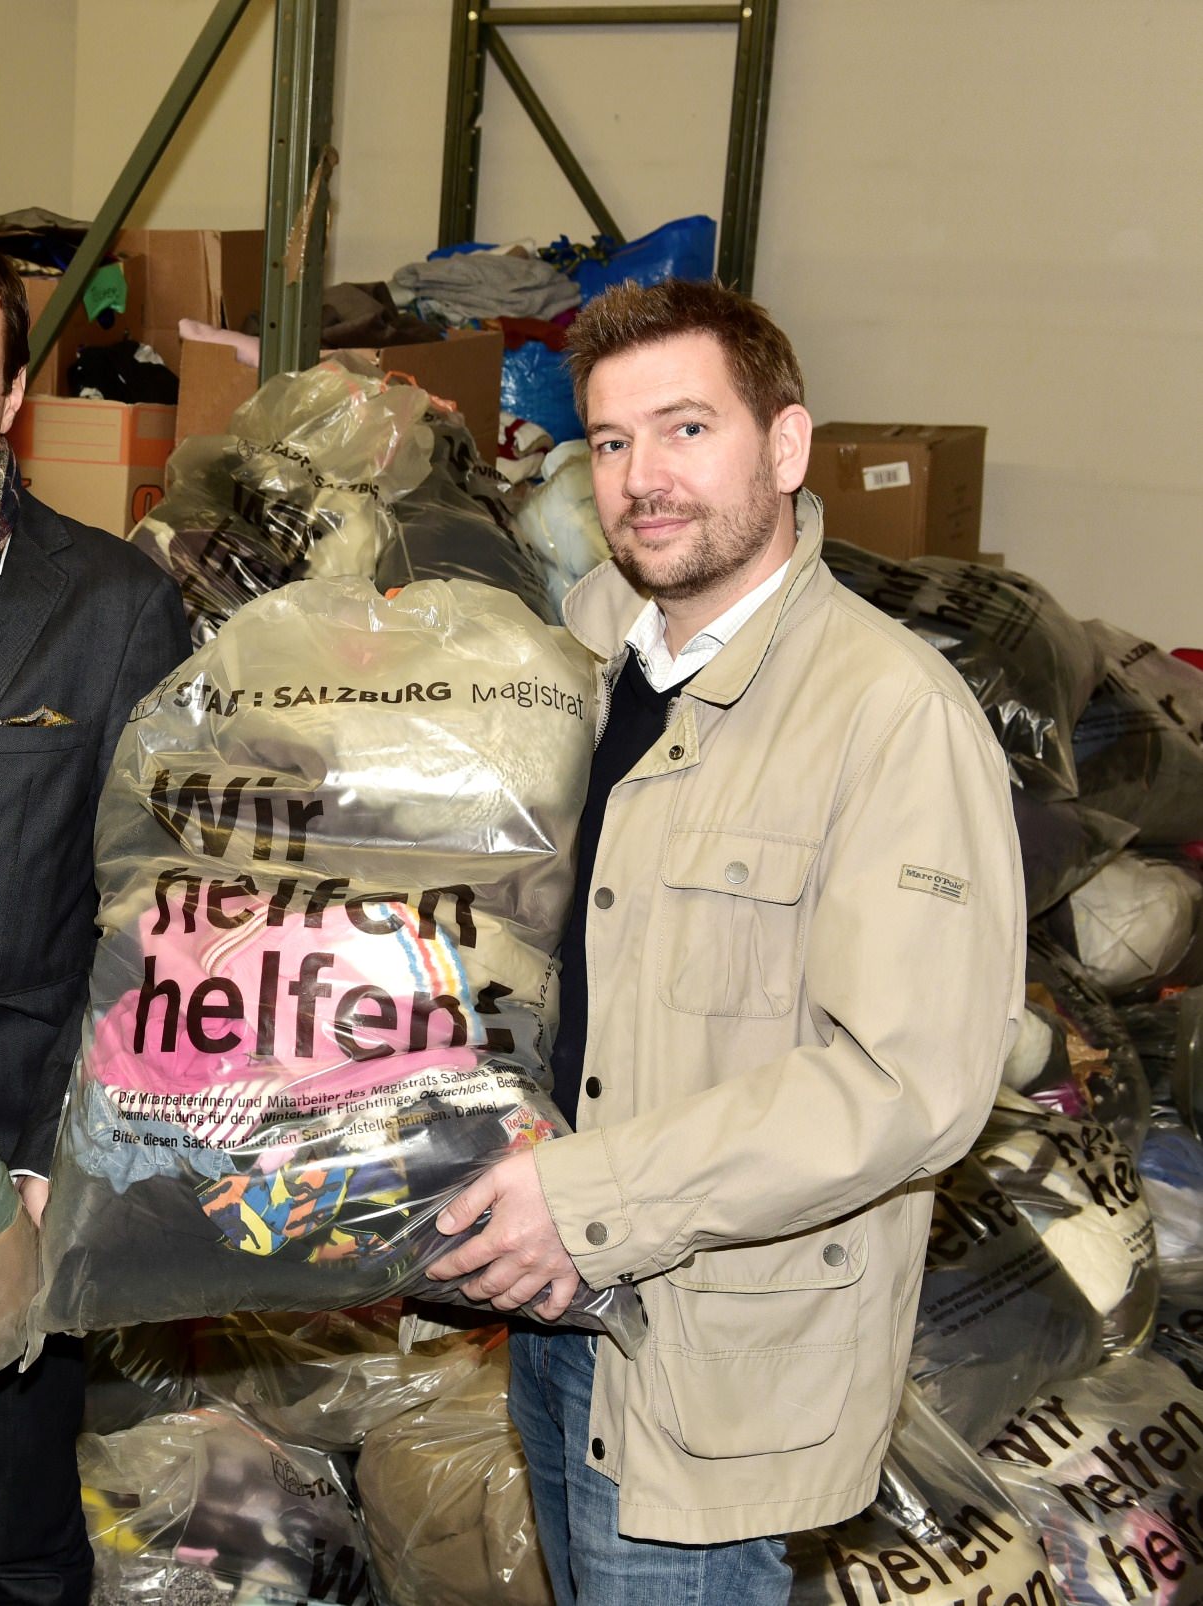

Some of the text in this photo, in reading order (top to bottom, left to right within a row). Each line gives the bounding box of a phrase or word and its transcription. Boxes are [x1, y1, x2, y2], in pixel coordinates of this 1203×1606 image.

[273, 681, 452, 708] SALZBURG
[471, 675, 585, 721] Magistrat
[150, 769, 324, 862] Wir
[905, 868, 933, 881] Marc
[117, 1109, 150, 1122] warme
[153, 1110, 204, 1126] Kleidung
[209, 1110, 227, 1124] für
[230, 1112, 255, 1126] den
[260, 1110, 305, 1125] Winter.
[310, 1103, 333, 1117] Für
[337, 1093, 414, 1115] Flüchtlinge,
[419, 1081, 494, 1099] Obdachlose,
[118, 1091, 135, 1105] Die
[138, 1092, 235, 1109] Mitarbeiterinnen
[238, 1095, 262, 1108] und
[267, 1091, 340, 1108] Mitarbeiter
[344, 1087, 366, 1099] des
[370, 1074, 438, 1098] Magistrats
[441, 1068, 490, 1085] Salzburg
[112, 1129, 140, 1145] Bitte
[144, 1131, 178, 1147] diesen
[183, 1135, 213, 1149] Sack
[217, 1138, 237, 1150] zur
[396, 1109, 451, 1129] bringen.
[455, 1102, 499, 1118] Danke!
